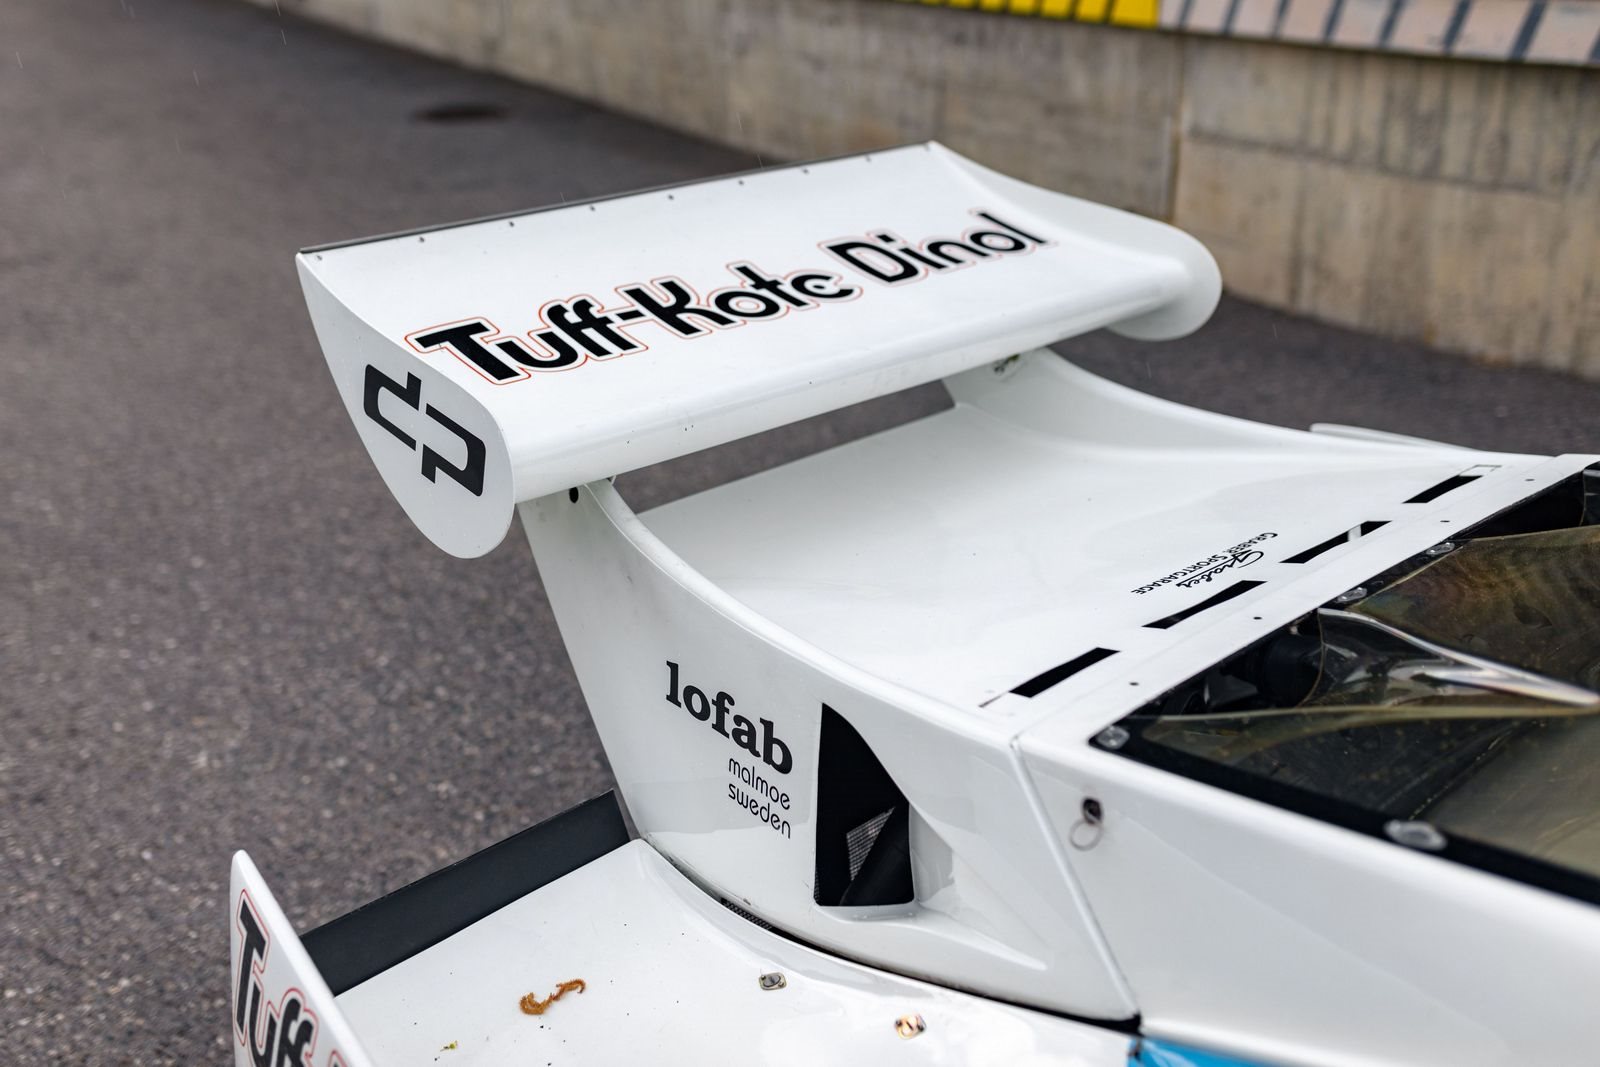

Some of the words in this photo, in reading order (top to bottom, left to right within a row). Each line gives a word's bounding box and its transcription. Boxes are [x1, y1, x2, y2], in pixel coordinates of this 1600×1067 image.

[411, 263, 858, 384] Tuff-Kote
[825, 210, 1050, 285] Dinol
[1223, 532, 1279, 553] GRABER
[1131, 553, 1228, 595] SPORTGARAGE
[665, 660, 793, 775] lofab
[728, 757, 791, 811] malmoe
[728, 783, 792, 839] sweden
[235, 897, 330, 1067] Tuff
